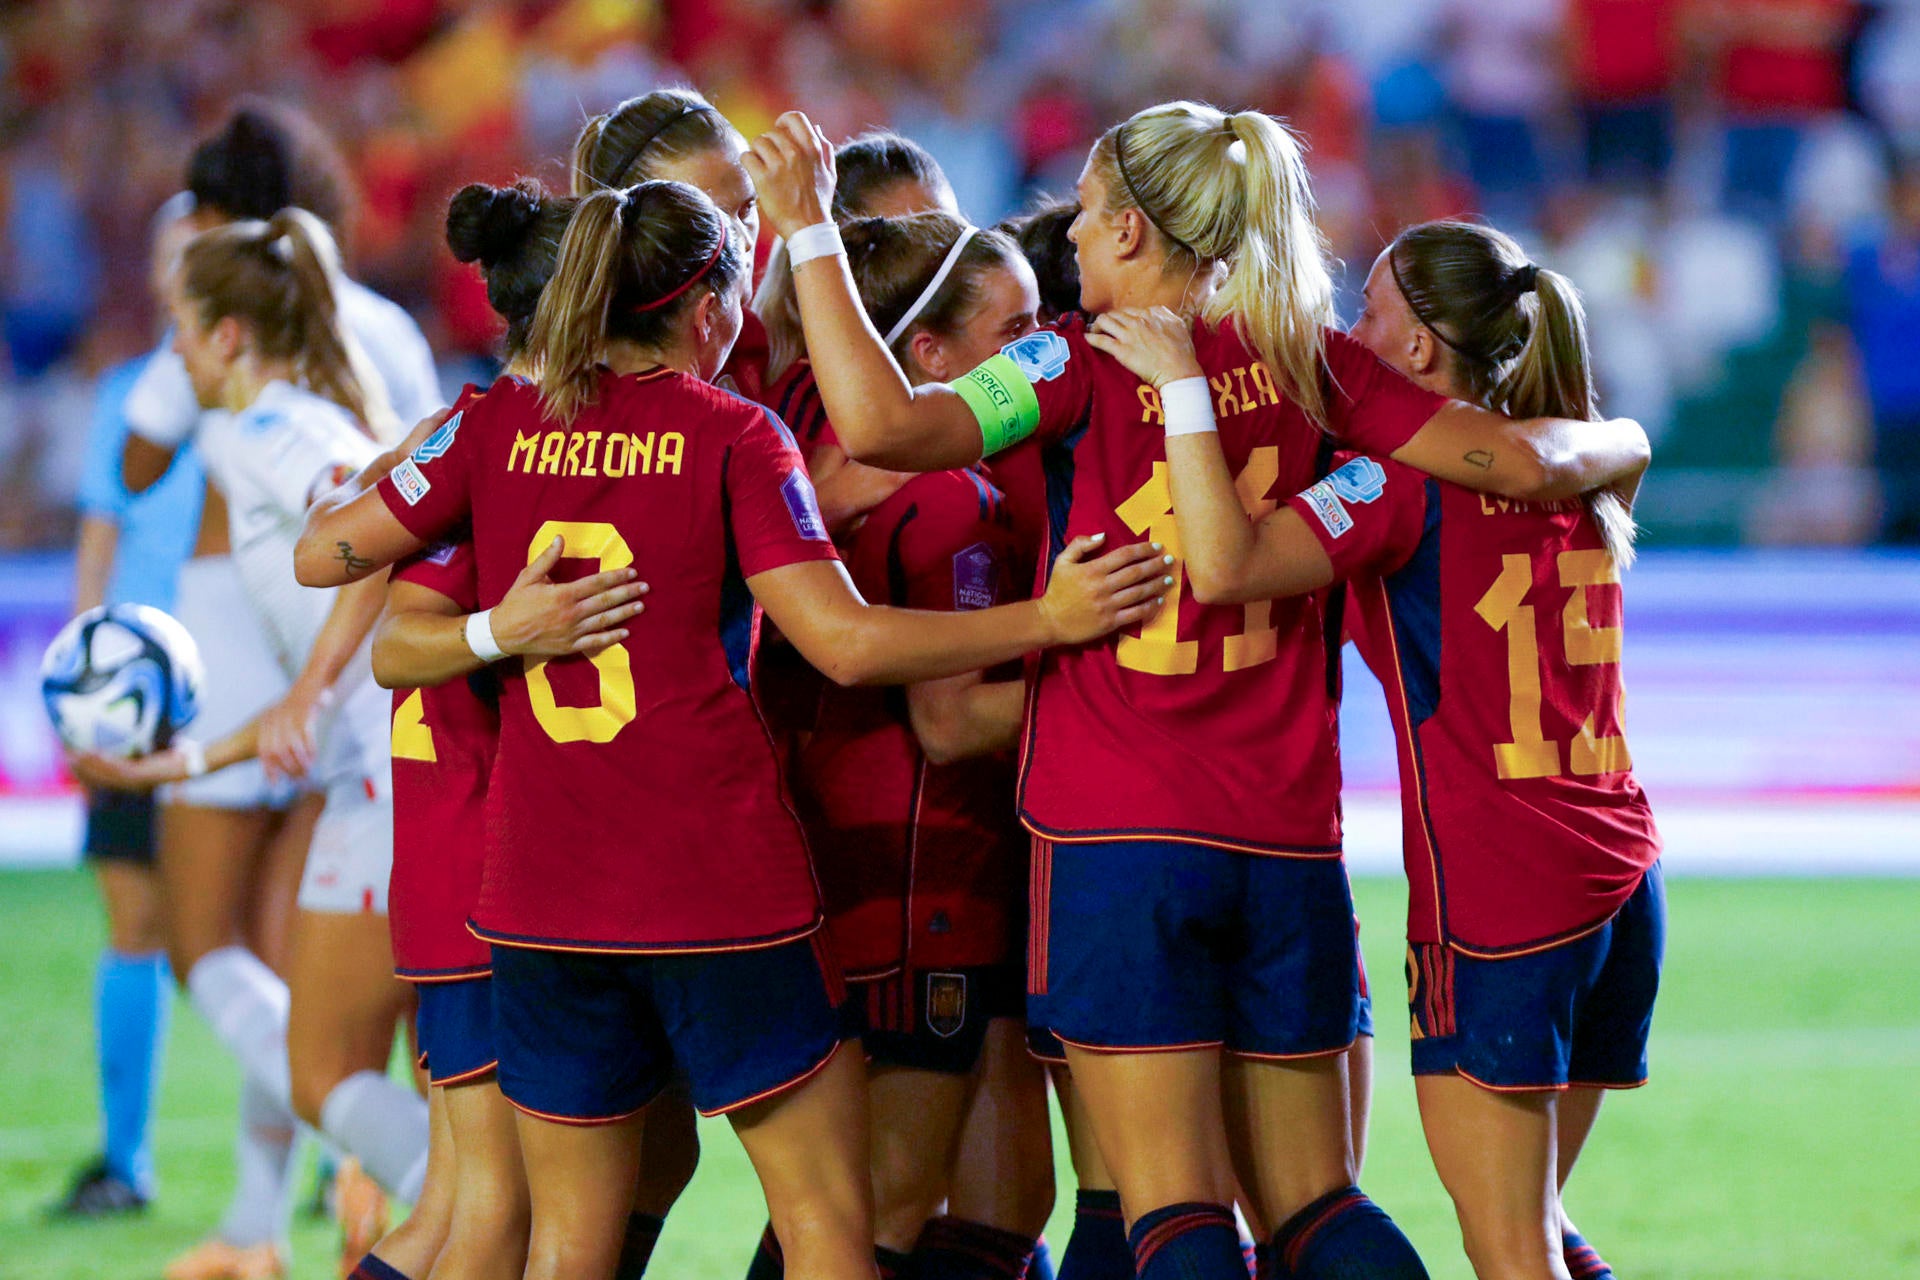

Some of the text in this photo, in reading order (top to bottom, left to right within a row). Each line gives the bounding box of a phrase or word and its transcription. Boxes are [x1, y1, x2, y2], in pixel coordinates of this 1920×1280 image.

[507, 429, 685, 478] MARIONA
[1137, 362, 1279, 426] AXIA
[524, 520, 637, 744] 8
[1115, 446, 1279, 676] 11
